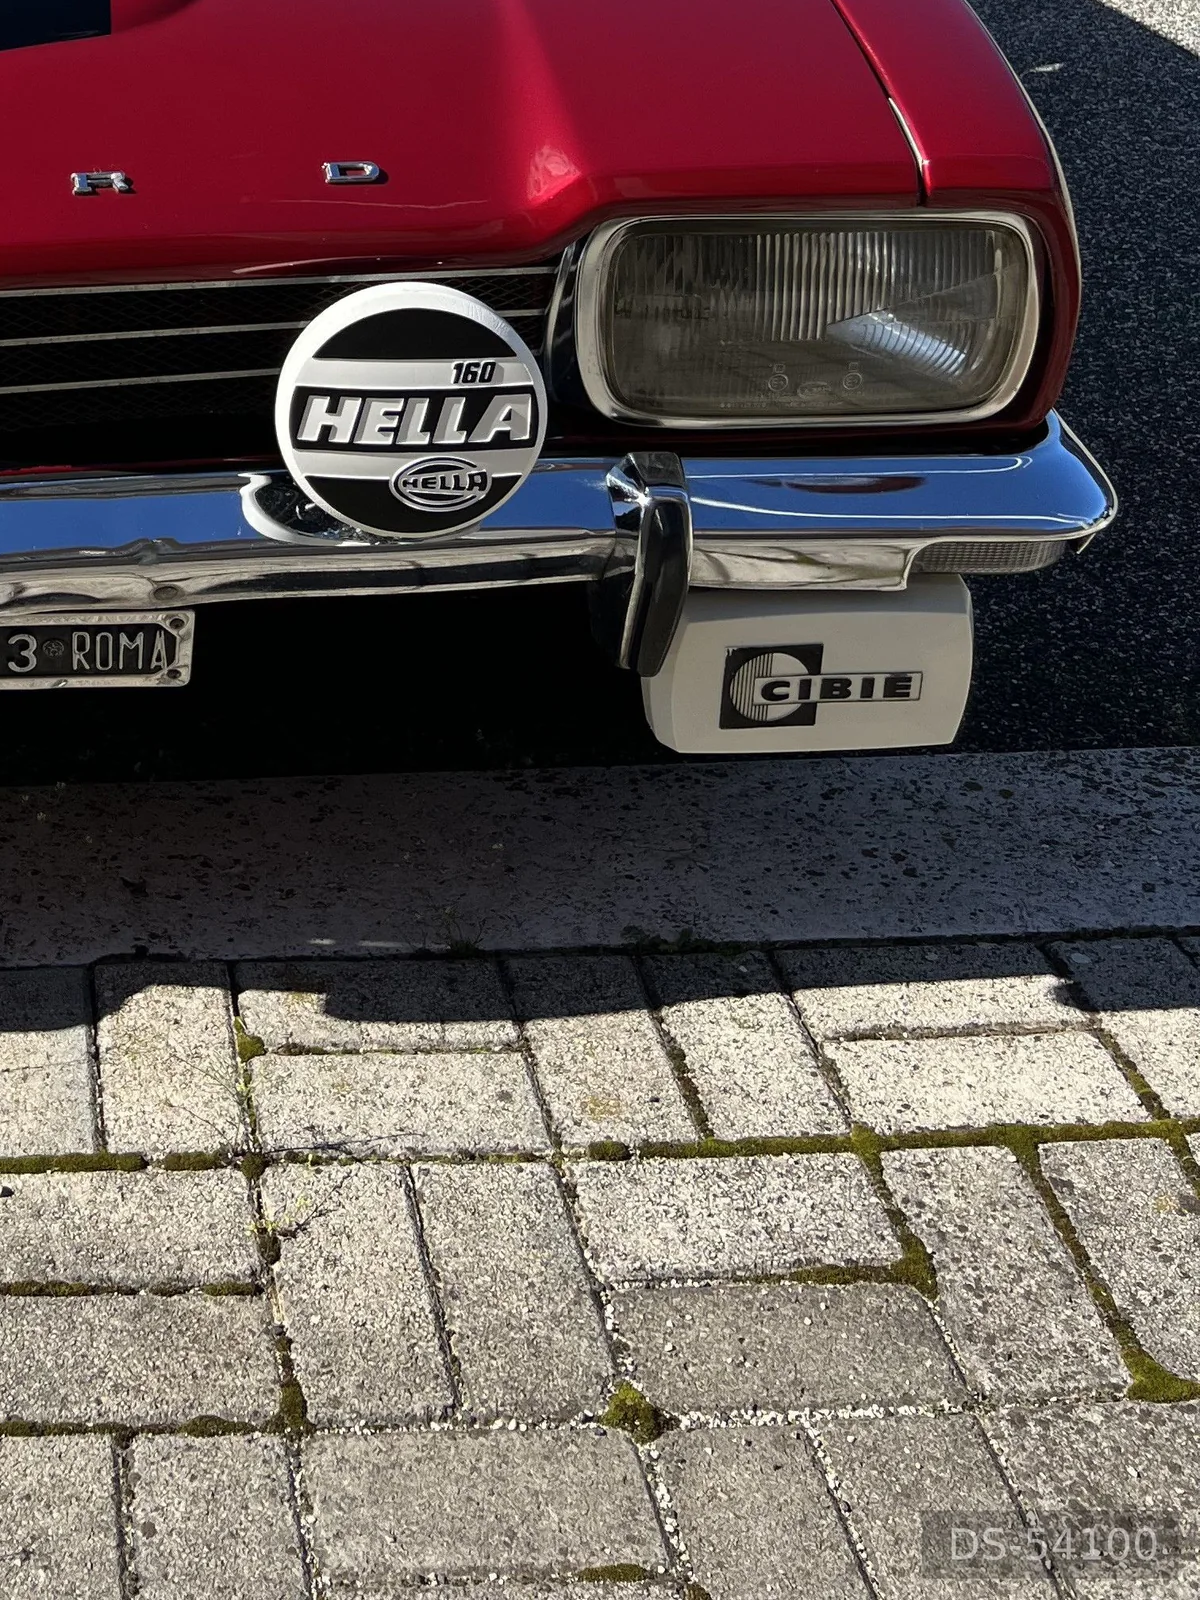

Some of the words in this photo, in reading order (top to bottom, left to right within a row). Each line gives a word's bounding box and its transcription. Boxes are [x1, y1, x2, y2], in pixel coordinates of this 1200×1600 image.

[452, 361, 497, 384] 160
[297, 394, 532, 445] HELLA
[401, 470, 488, 492] HELLA
[71, 630, 168, 673] ROMA
